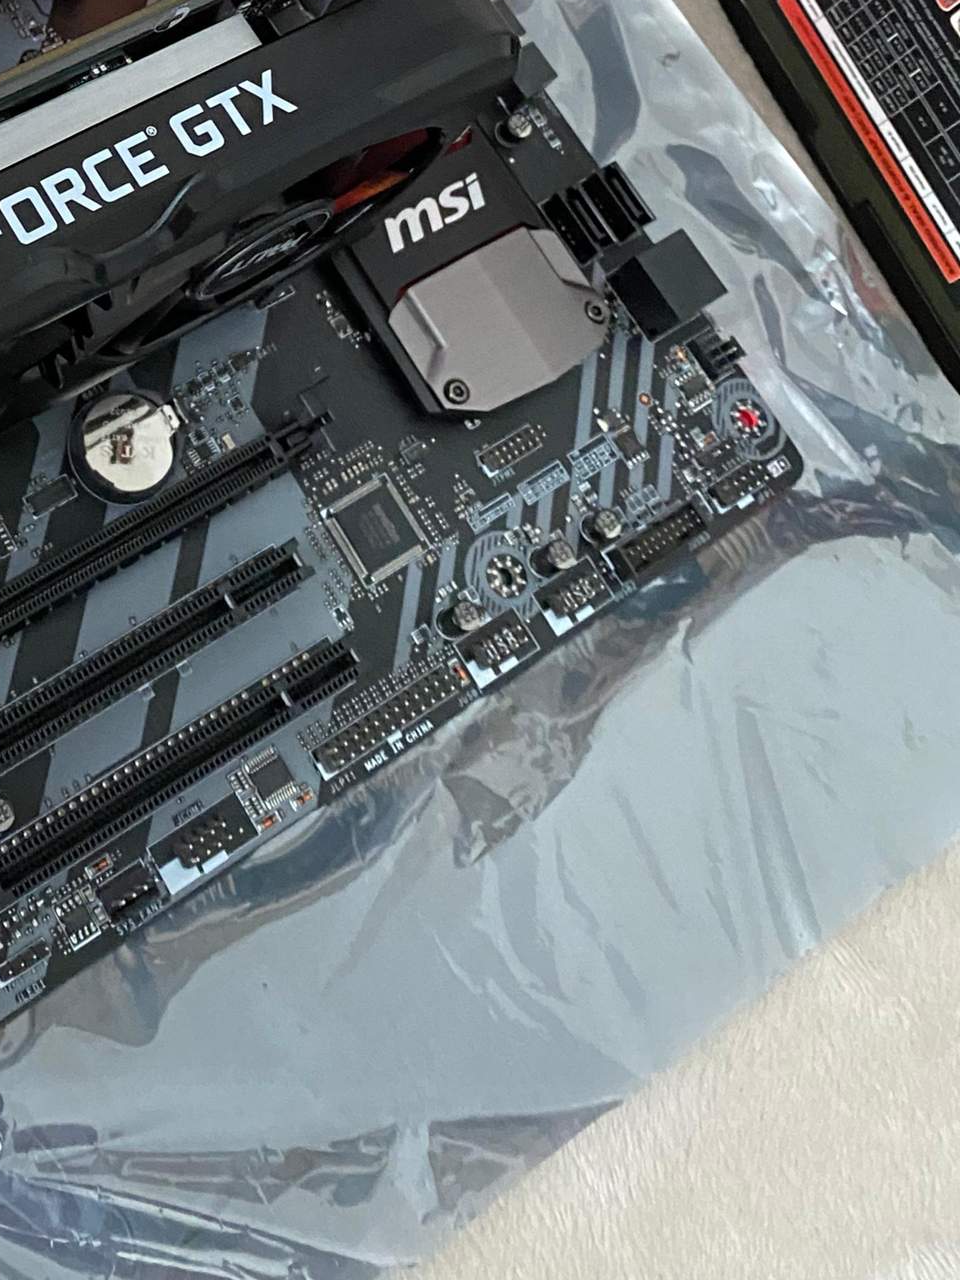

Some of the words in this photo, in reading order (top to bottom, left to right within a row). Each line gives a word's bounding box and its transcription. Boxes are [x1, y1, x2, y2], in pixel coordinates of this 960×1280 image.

[168, 67, 298, 158] GTX
[384, 172, 486, 254] msi
[364, 749, 389, 773] MADE
[405, 718, 435, 744] CHINA
